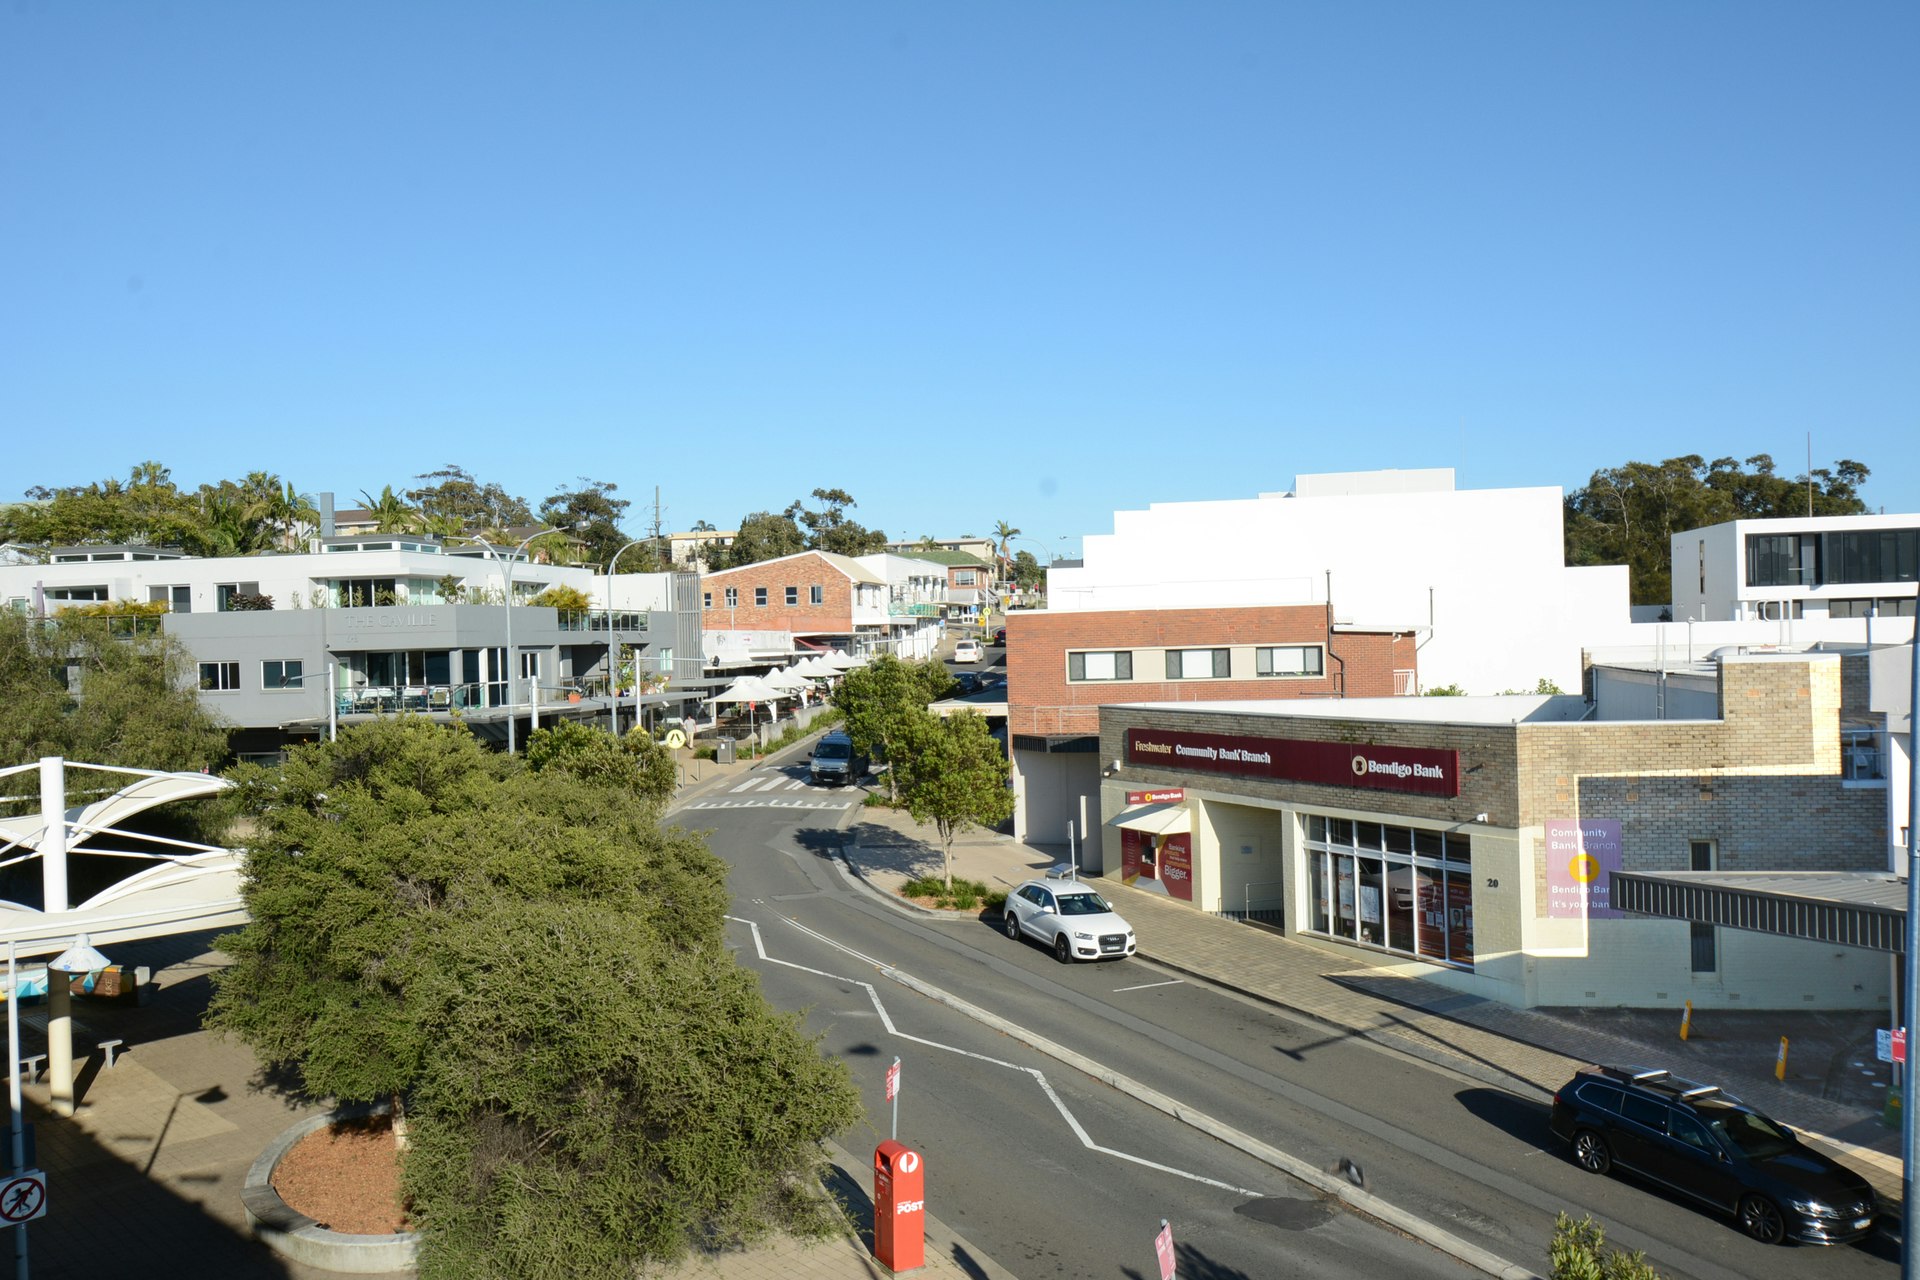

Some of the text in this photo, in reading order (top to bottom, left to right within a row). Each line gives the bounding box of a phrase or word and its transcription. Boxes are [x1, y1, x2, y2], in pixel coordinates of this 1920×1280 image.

[344, 614, 374, 628] THE
[1135, 740, 1172, 754] Freshwater
[1175, 744, 1217, 760] Community
[1241, 750, 1271, 764] Branch
[1368, 760, 1443, 779] Bendigo Bank
[1583, 841, 1617, 850] Branch
[1487, 878, 1499, 889] 20
[1552, 885, 1610, 894] Bendio Ban
[1592, 901, 1610, 909] ban
[897, 1200, 924, 1215] POST
